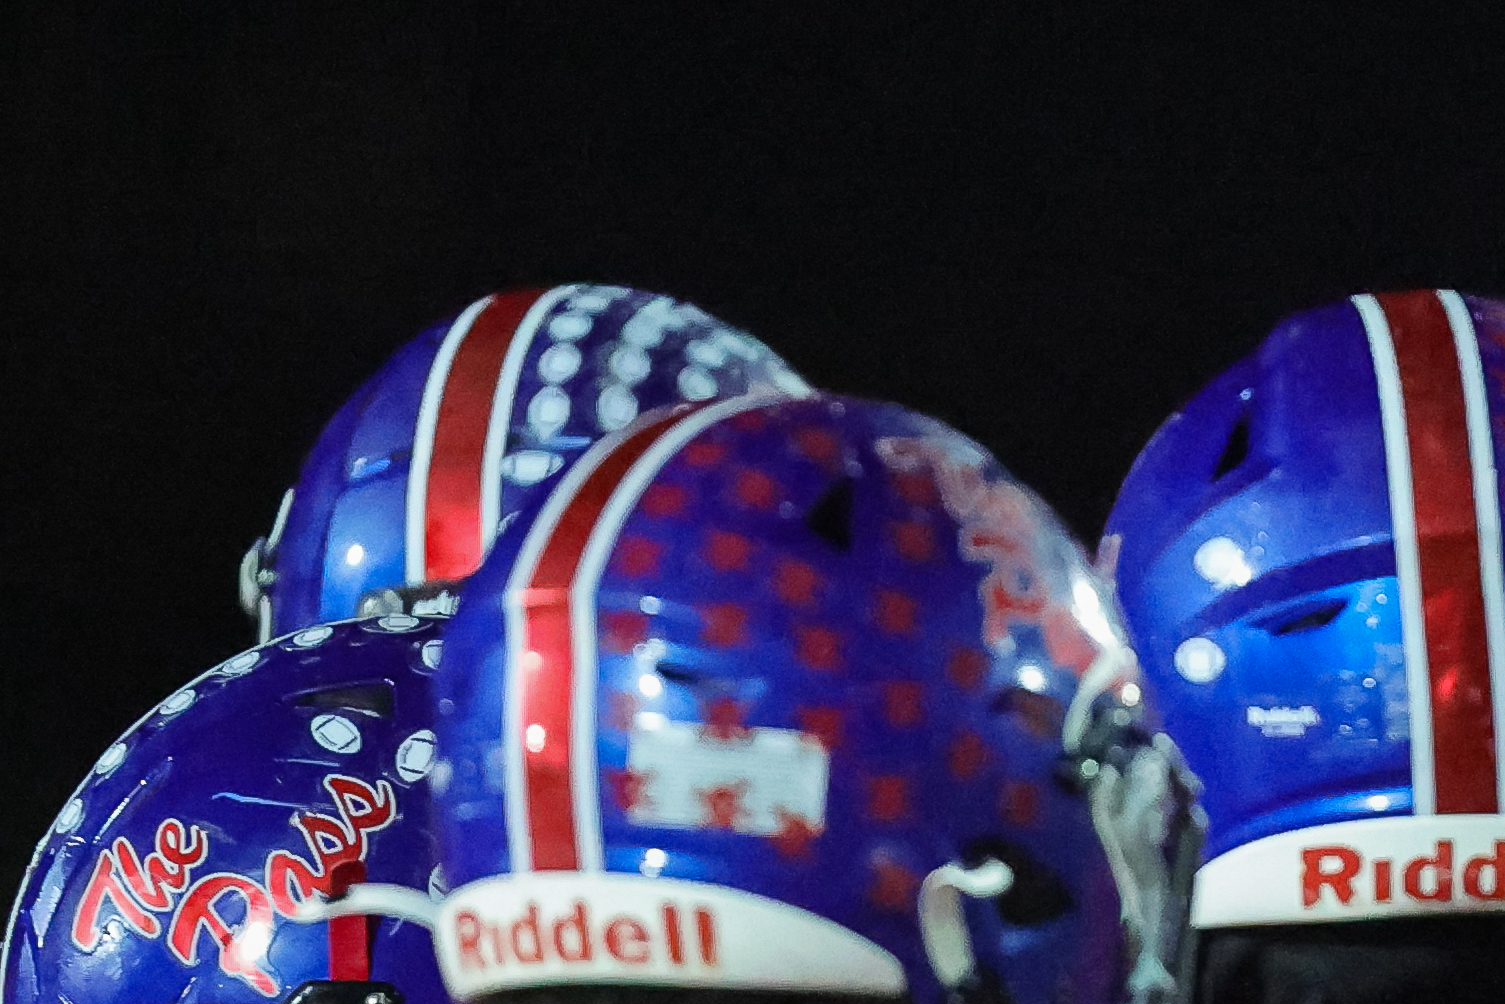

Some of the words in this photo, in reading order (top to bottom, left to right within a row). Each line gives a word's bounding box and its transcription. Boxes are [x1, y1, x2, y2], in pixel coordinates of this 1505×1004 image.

[72, 818, 208, 953] The
[168, 774, 396, 996] Pass
[454, 905, 719, 972] Riddell
